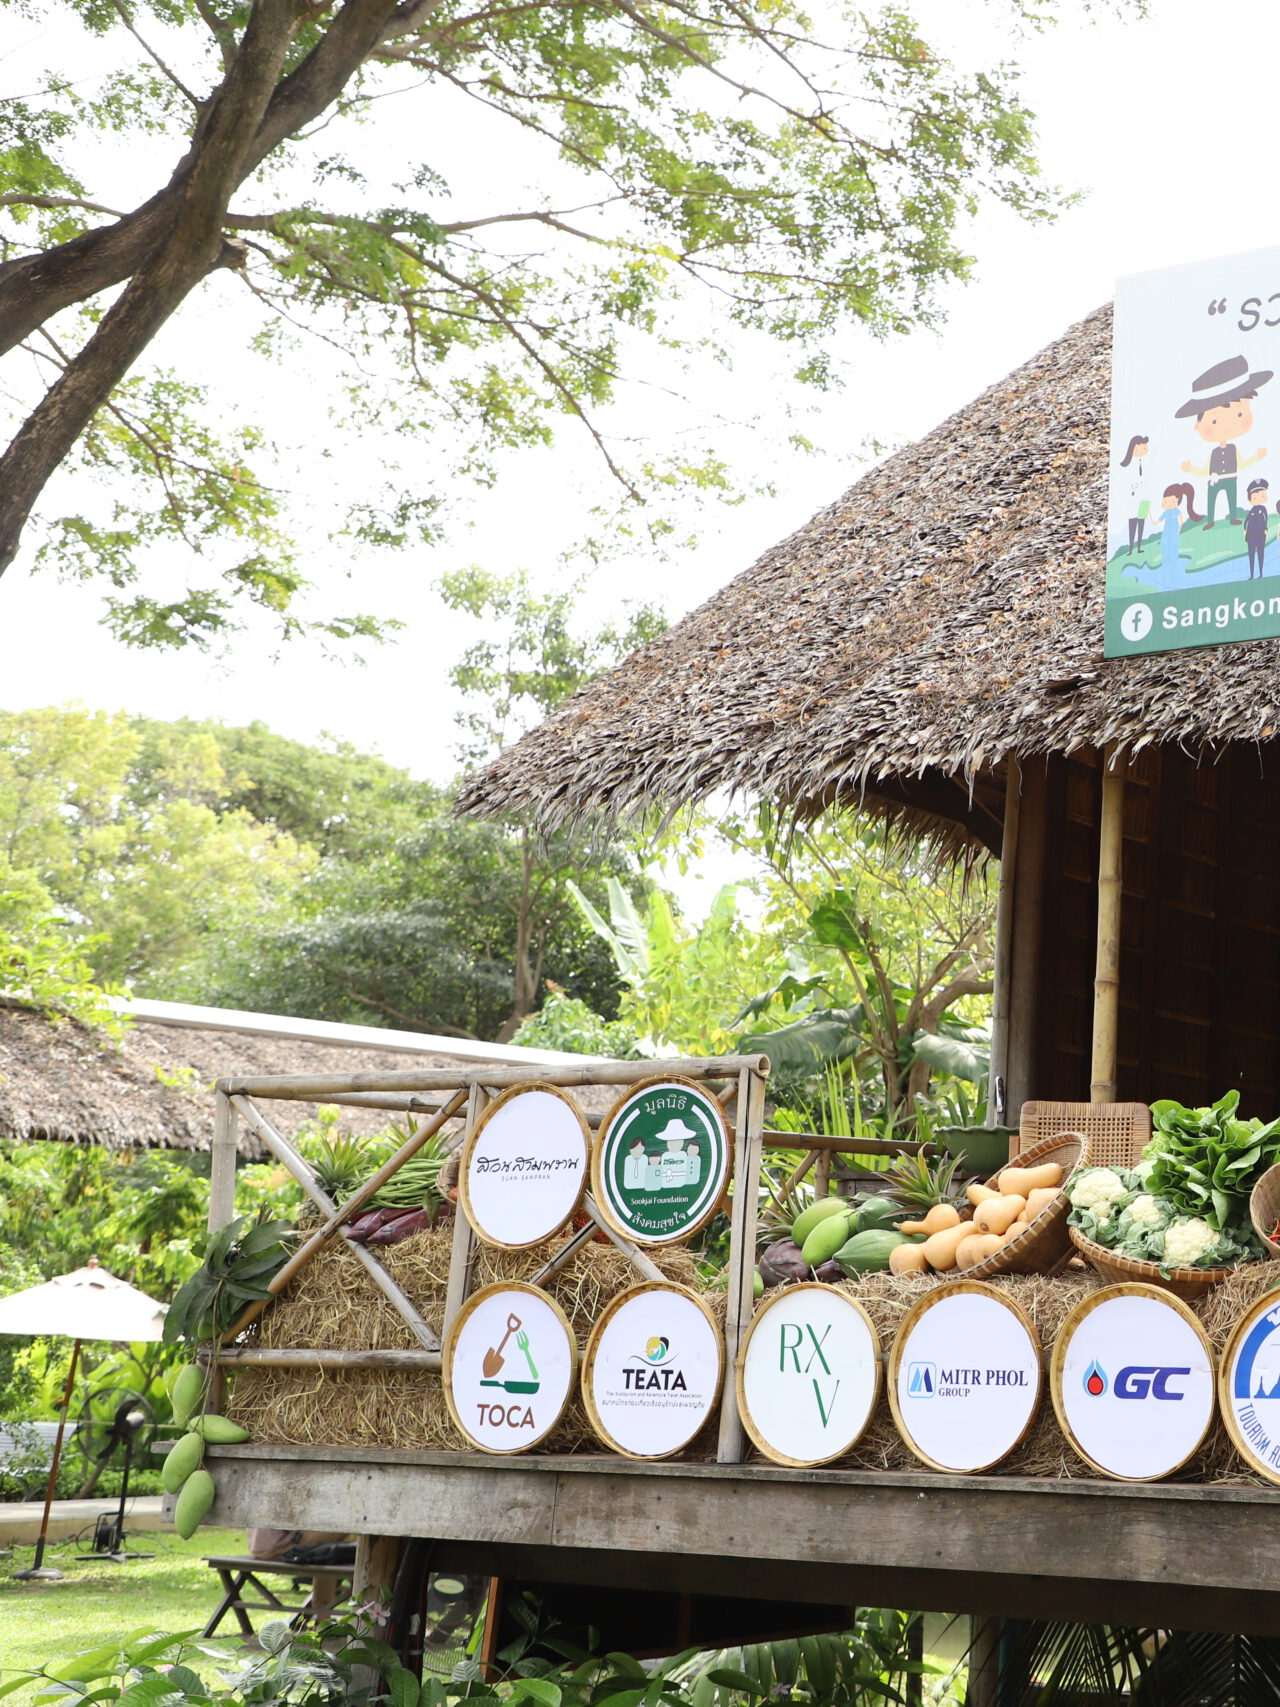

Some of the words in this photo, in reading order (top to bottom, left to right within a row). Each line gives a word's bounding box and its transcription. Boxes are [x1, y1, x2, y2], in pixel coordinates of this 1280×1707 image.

[645, 1093, 687, 1115] มูลนิธิ
[631, 1196, 652, 1207] Sookjai
[653, 1195, 689, 1205] Foundation
[632, 1211, 687, 1232] สังคมสุขใจ
[779, 1322, 832, 1376] RX
[622, 1368, 688, 1391] TEATA
[939, 1367, 982, 1386] MITR
[985, 1368, 1029, 1388] PHOL
[1113, 1366, 1192, 1401] GC
[812, 1378, 840, 1429] V
[938, 1387, 971, 1397] GROUP
[477, 1403, 536, 1429] TOCA
[1237, 1402, 1271, 1456] TOURISM
